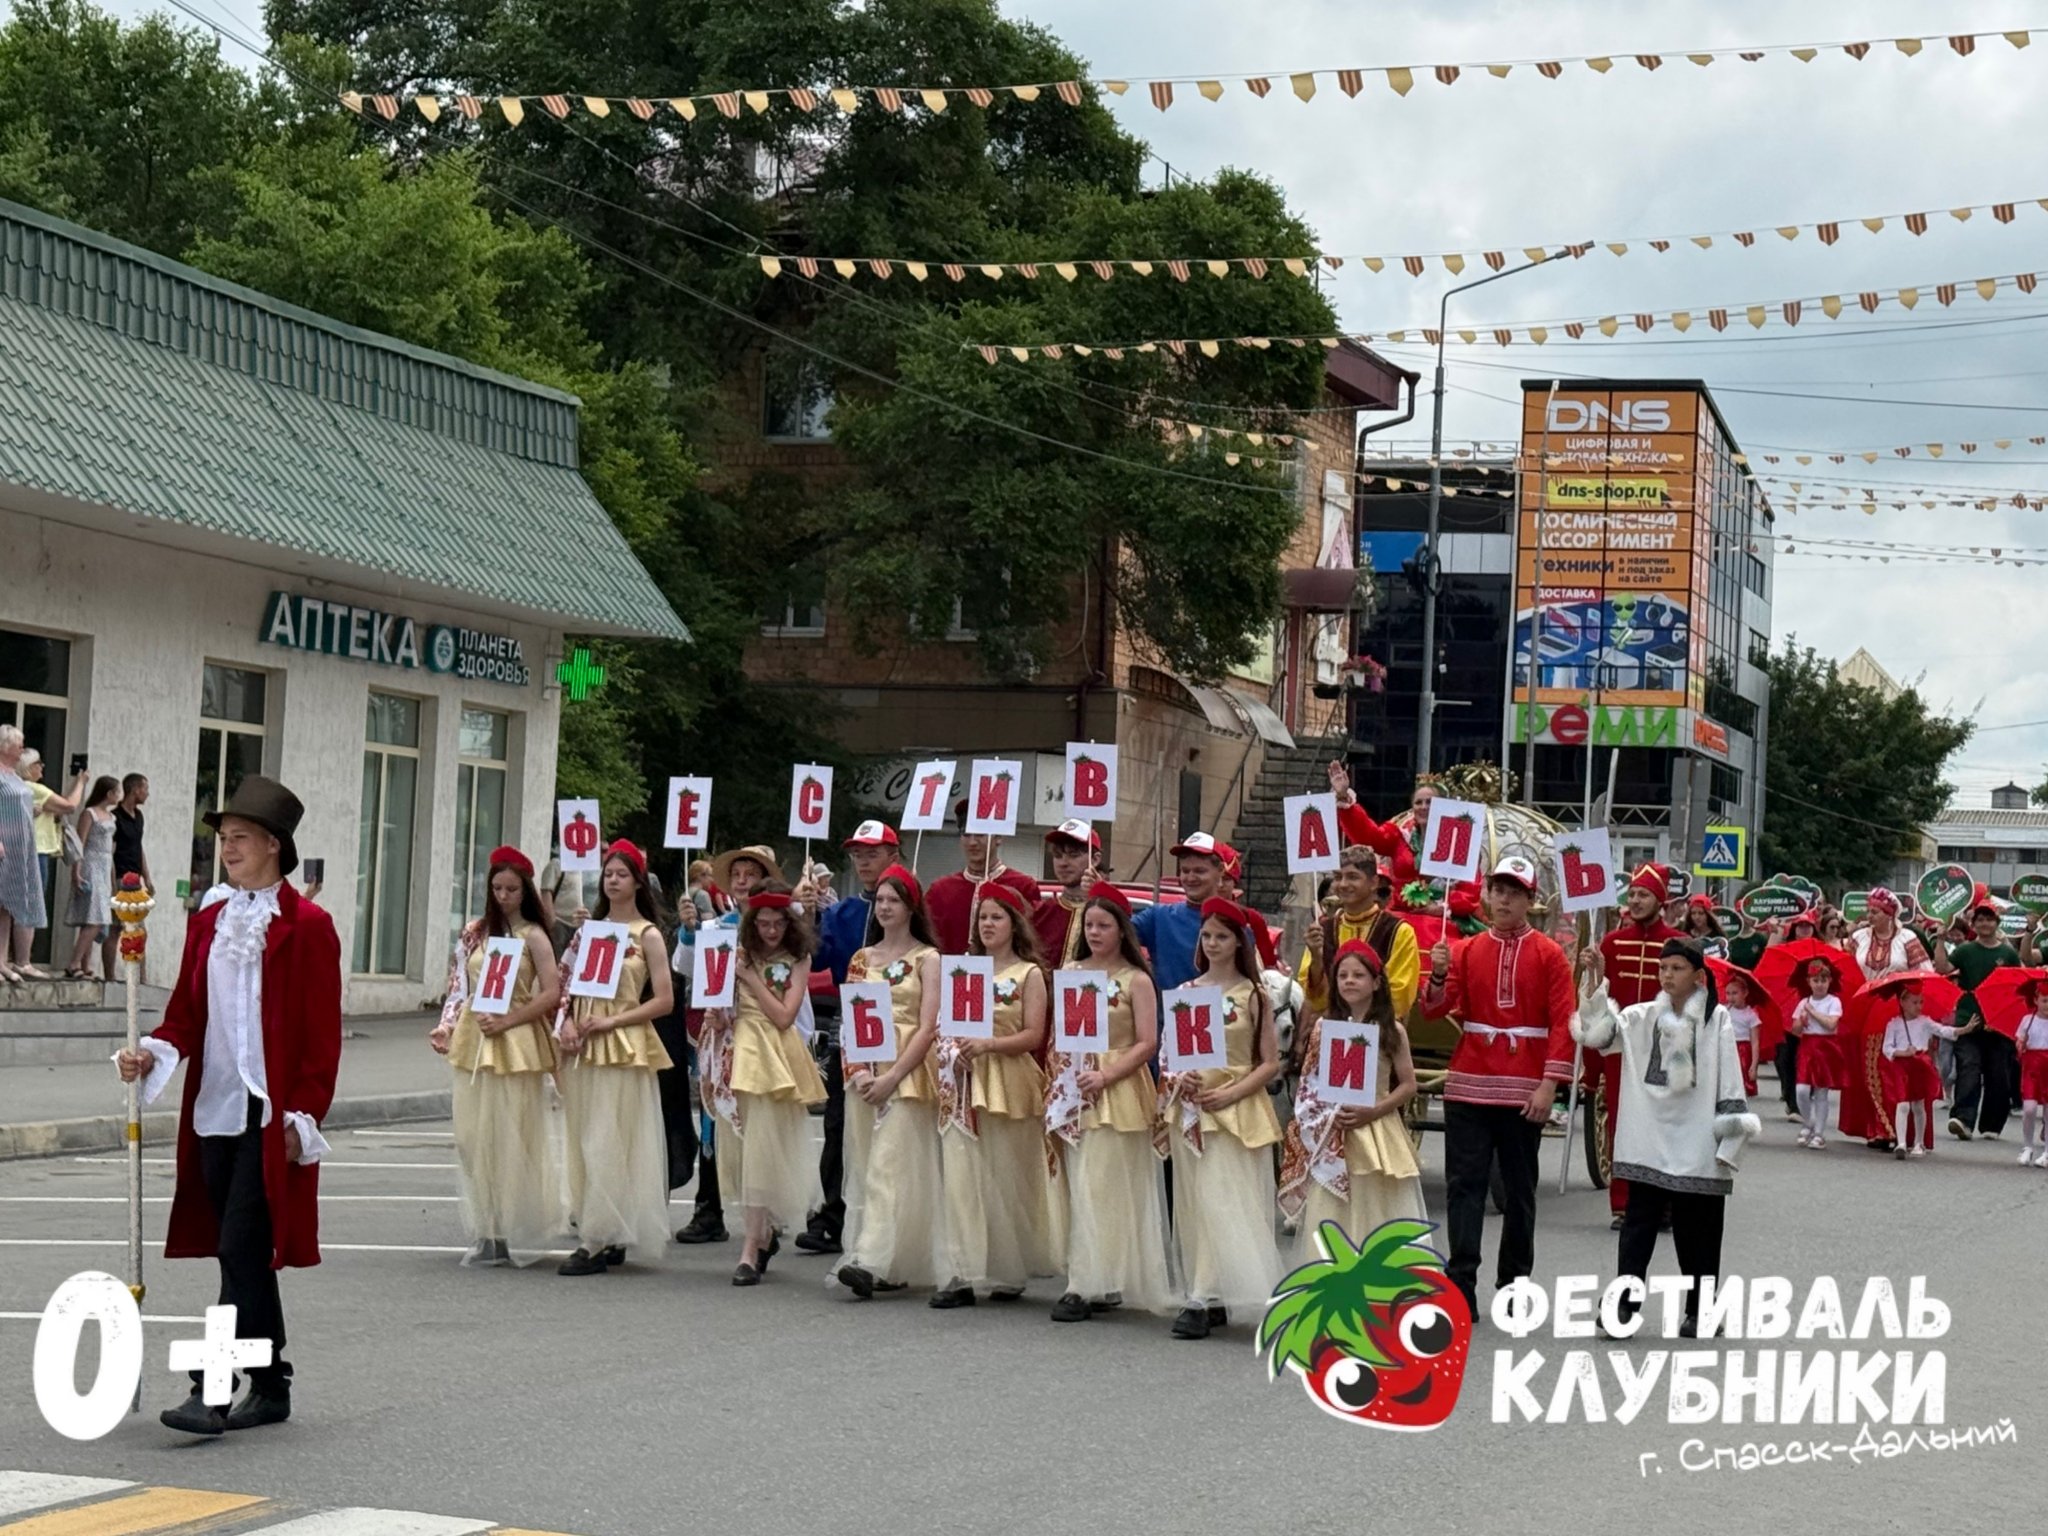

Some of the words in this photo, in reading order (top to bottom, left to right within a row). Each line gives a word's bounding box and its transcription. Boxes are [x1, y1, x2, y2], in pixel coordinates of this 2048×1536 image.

[1547, 399, 1672, 432] DNS
[1642, 437, 1652, 450] И
[1557, 483, 1658, 502] dns-shop.ru
[262, 591, 419, 668] АПТЕКА
[457, 628, 524, 661] ПЛАНЕТА
[456, 654, 531, 686] ЗДОРОВЬЯ
[564, 814, 598, 858] Ф
[676, 792, 701, 835] Е
[798, 780, 825, 825] С
[918, 774, 947, 817] Т
[975, 775, 1011, 821] И
[1073, 759, 1109, 807] В
[1298, 810, 1331, 859] А
[1429, 814, 1475, 867] Л
[1561, 851, 1606, 899] Ь
[481, 953, 514, 1000] К
[578, 936, 619, 985] Л
[702, 946, 731, 997] У
[852, 998, 885, 1048] Б
[952, 973, 985, 1022] Н
[1063, 987, 1098, 1037] И
[1174, 1003, 1215, 1057] К
[1328, 1037, 1368, 1090] И
